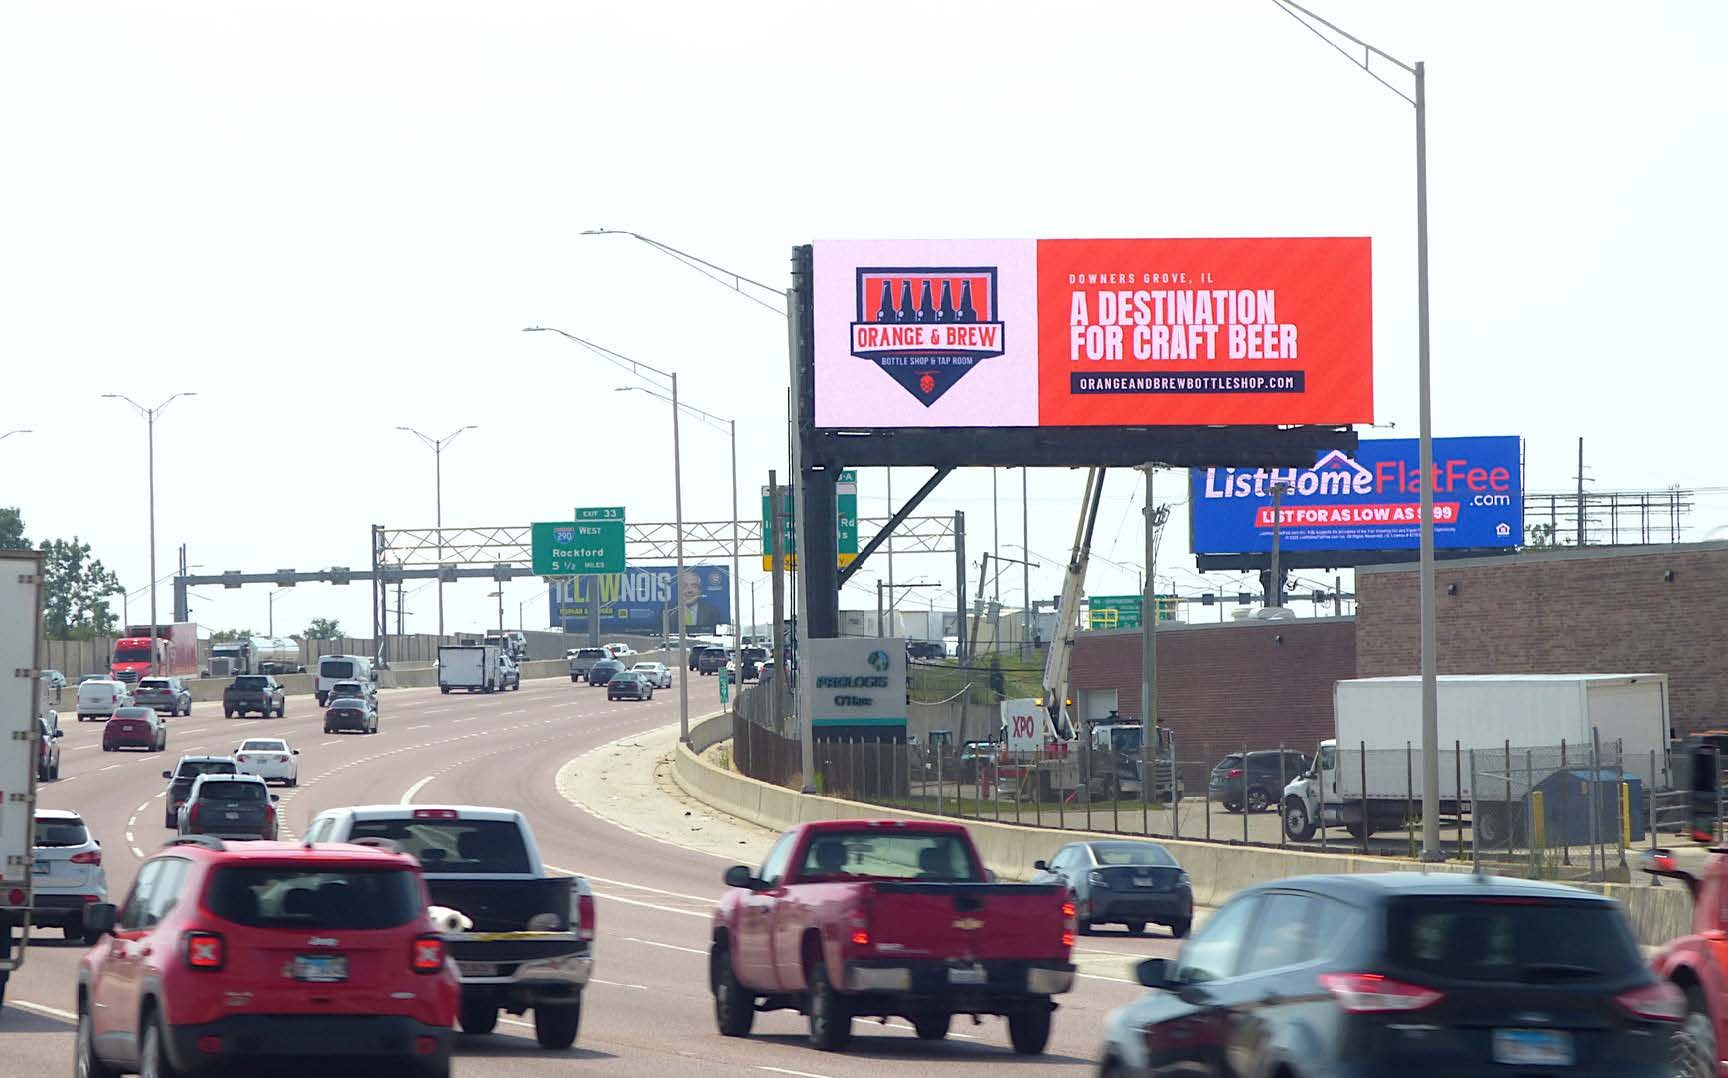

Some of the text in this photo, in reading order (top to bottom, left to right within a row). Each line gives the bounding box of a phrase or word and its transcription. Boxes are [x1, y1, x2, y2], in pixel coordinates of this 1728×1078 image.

[1069, 272, 1214, 285] DOWNERS GROVE, IL
[1069, 289, 1275, 325] A DESTINATION
[857, 327, 997, 347] ORANGE & BREW
[1070, 324, 1298, 361] FOR CRAFT BEER
[881, 357, 908, 366] BOTTLE
[910, 357, 929, 366] SHOP
[937, 357, 951, 365] TAP
[952, 356, 973, 365] ROOM
[1080, 376, 1294, 390] ORANGEANDBREWBOTTLESHOP.COM
[1469, 494, 1510, 506] .com
[604, 509, 617, 518] 33
[1262, 510, 1295, 524] LIST
[1297, 509, 1328, 523] FOR
[1331, 509, 1351, 522] AS
[1354, 508, 1390, 521] LOW
[1393, 507, 1415, 521] AS
[841, 518, 855, 527] Rd
[557, 527, 601, 540] 290 WEST
[552, 548, 604, 558] Rockford
[552, 561, 560, 570] 5
[556, 572, 672, 603] ILLWNOIS
[1013, 716, 1034, 738] XPO
